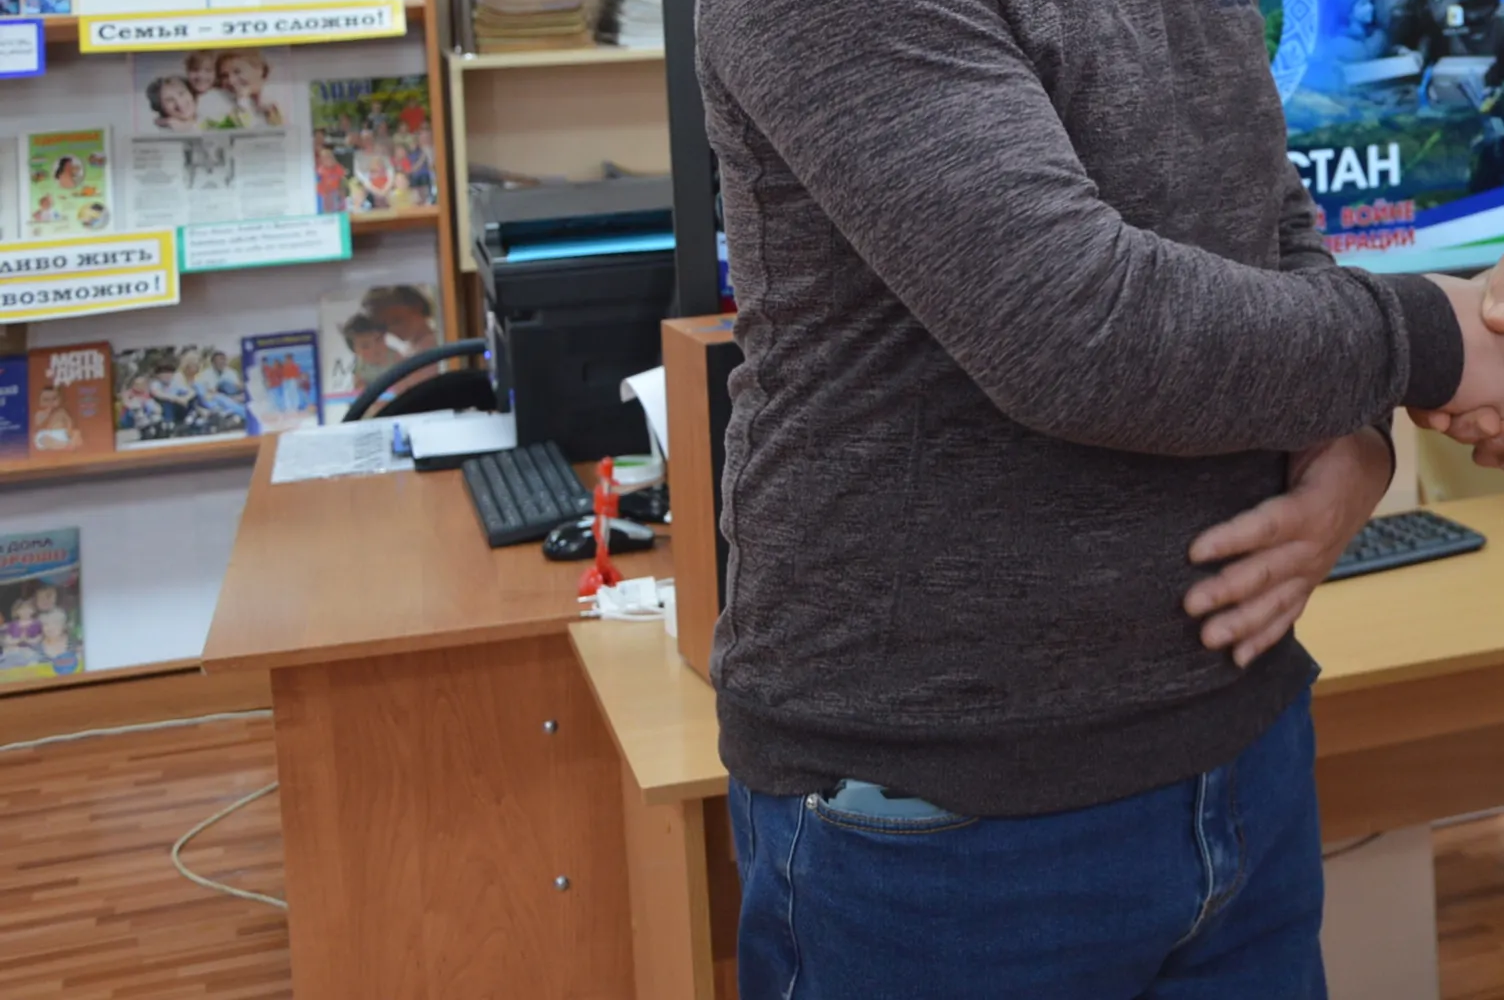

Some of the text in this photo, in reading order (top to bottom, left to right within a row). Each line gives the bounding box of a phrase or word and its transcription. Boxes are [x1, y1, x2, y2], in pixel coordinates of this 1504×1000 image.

[97, 23, 189, 41] Семья
[222, 18, 268, 35] это
[274, 10, 385, 34] сложно!
[1341, 198, 1416, 229] ВОЙНЕ
[77, 249, 153, 266] жить
[1, 274, 160, 306] возможно!
